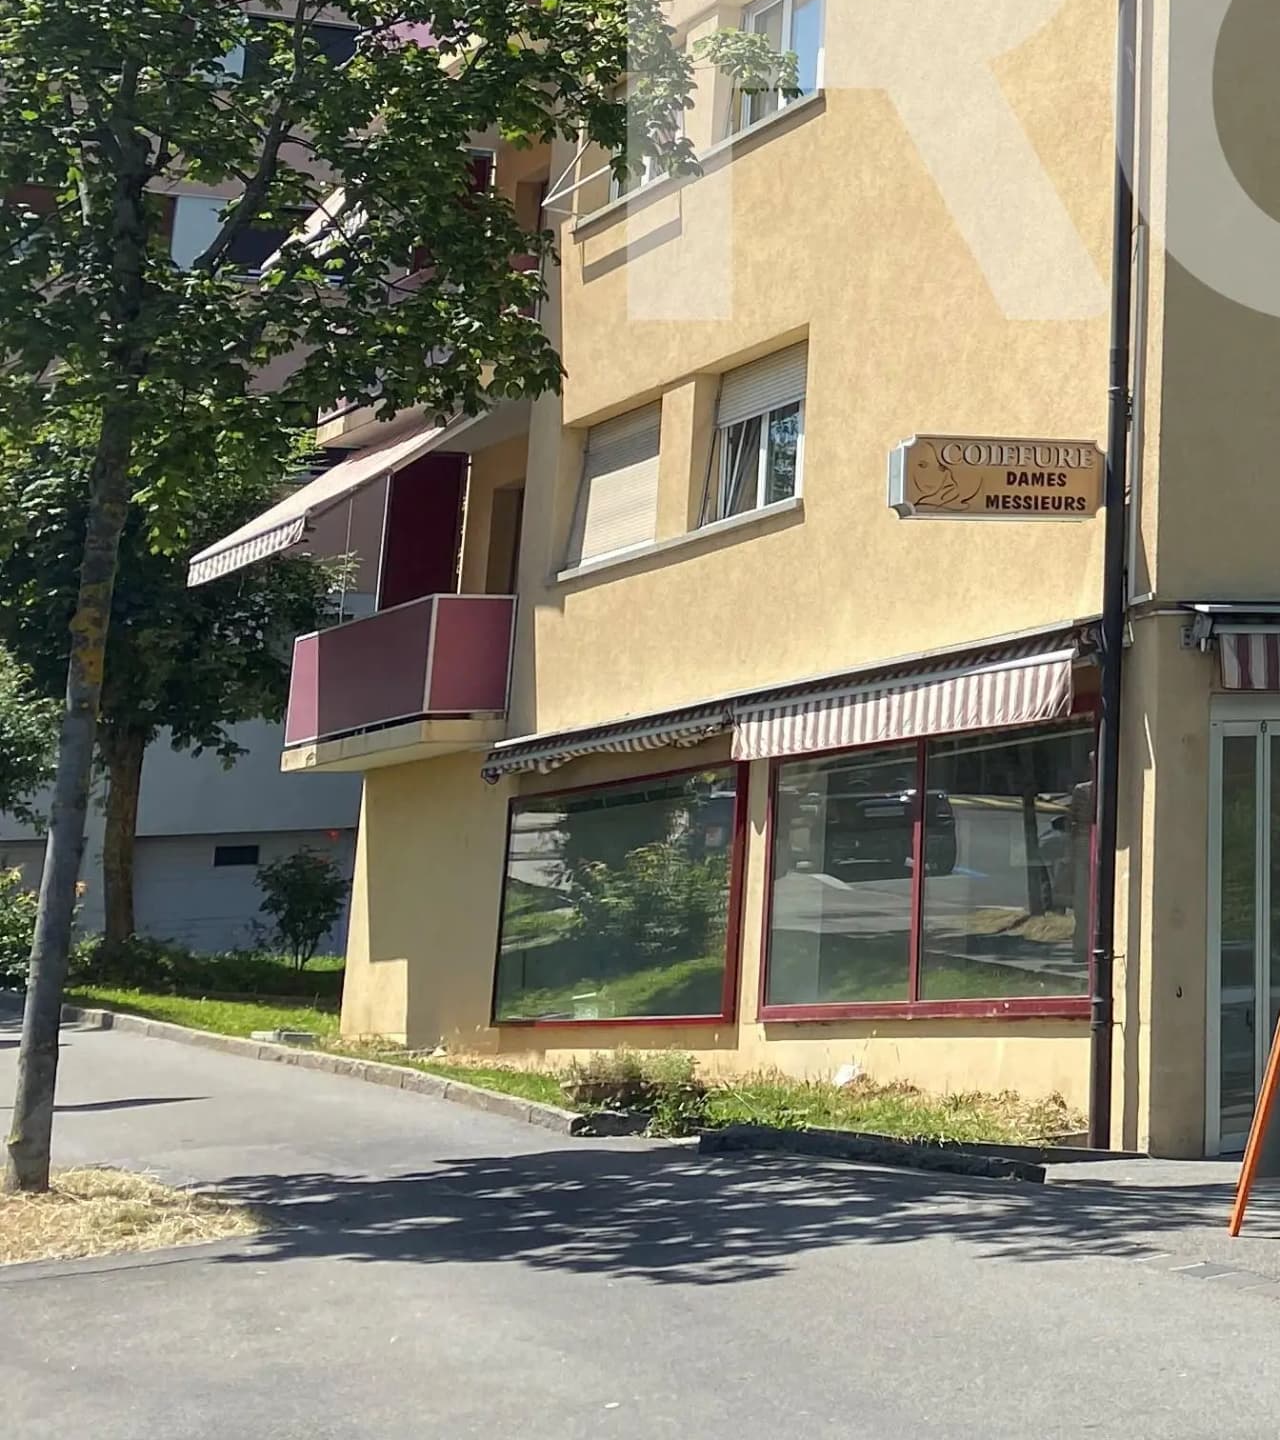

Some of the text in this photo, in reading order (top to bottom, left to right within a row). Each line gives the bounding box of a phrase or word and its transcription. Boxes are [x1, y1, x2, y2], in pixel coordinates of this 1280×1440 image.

[940, 443, 1094, 469] COIFFURE
[1006, 471, 1067, 487] DAMES
[985, 495, 1086, 511] MESSIEURS
